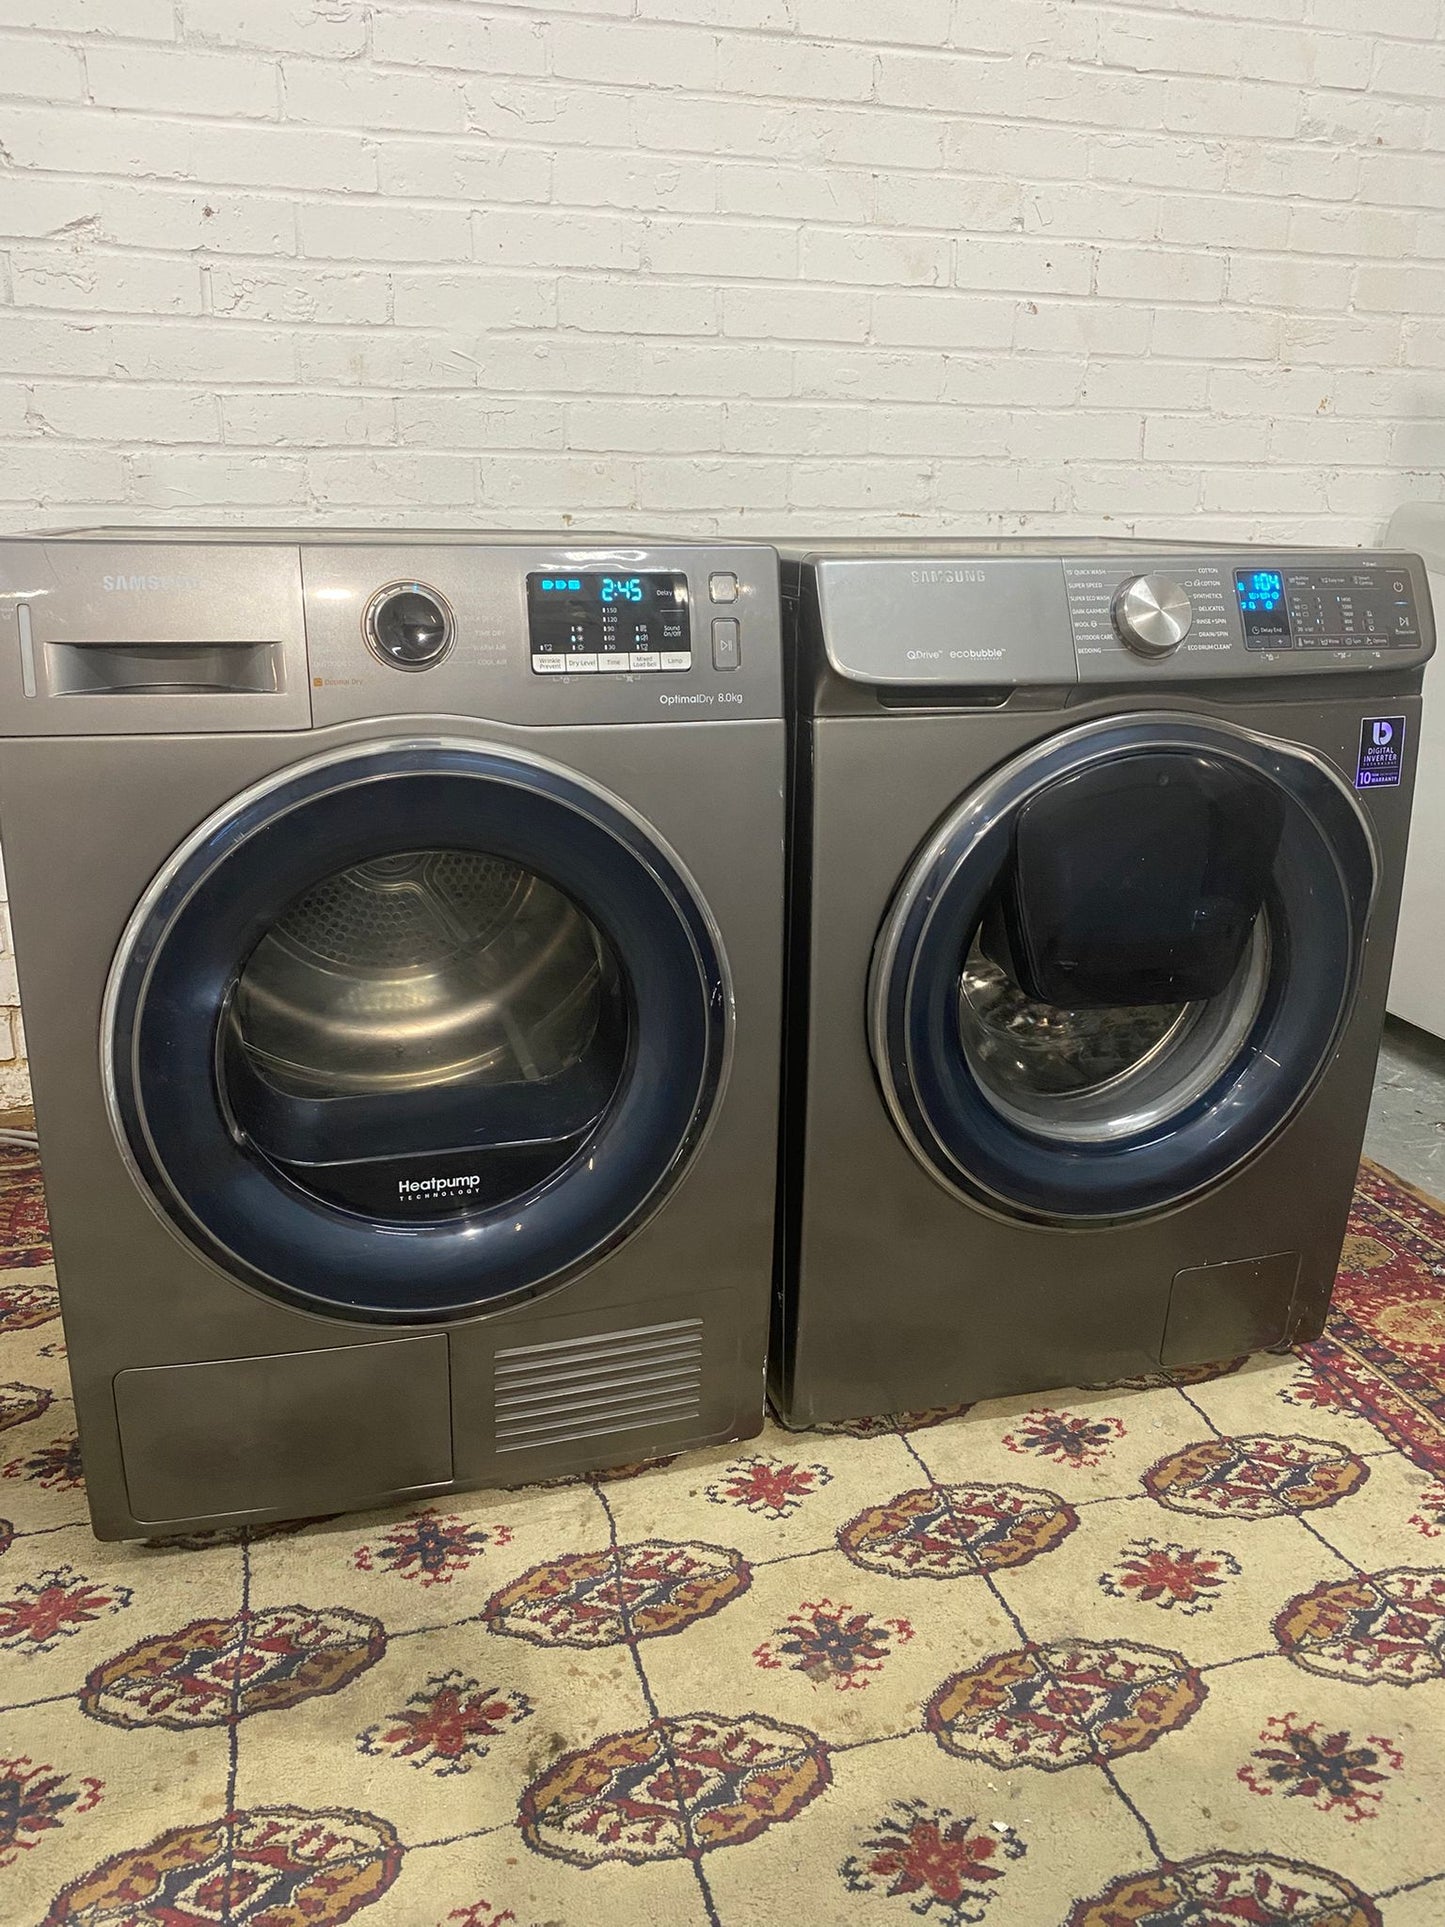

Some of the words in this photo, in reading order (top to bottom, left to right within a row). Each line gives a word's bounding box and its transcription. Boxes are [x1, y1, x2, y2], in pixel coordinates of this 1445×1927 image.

[911, 570, 986, 583] SAMSUNG
[602, 578, 642, 602] 2:45
[656, 588, 673, 597] Delay
[569, 659, 580, 667] Dry
[580, 658, 596, 667] Level
[667, 657, 683, 665] Lamp
[659, 693, 715, 706] OptimalDry
[718, 692, 743, 705] 8.0kg
[1368, 747, 1394, 755] DIGITAL
[1363, 753, 1397, 763] INVERTER
[1359, 771, 1372, 784] 10
[399, 1175, 480, 1193] Heatpump
[400, 1188, 480, 1202] TECHNOLOGY
